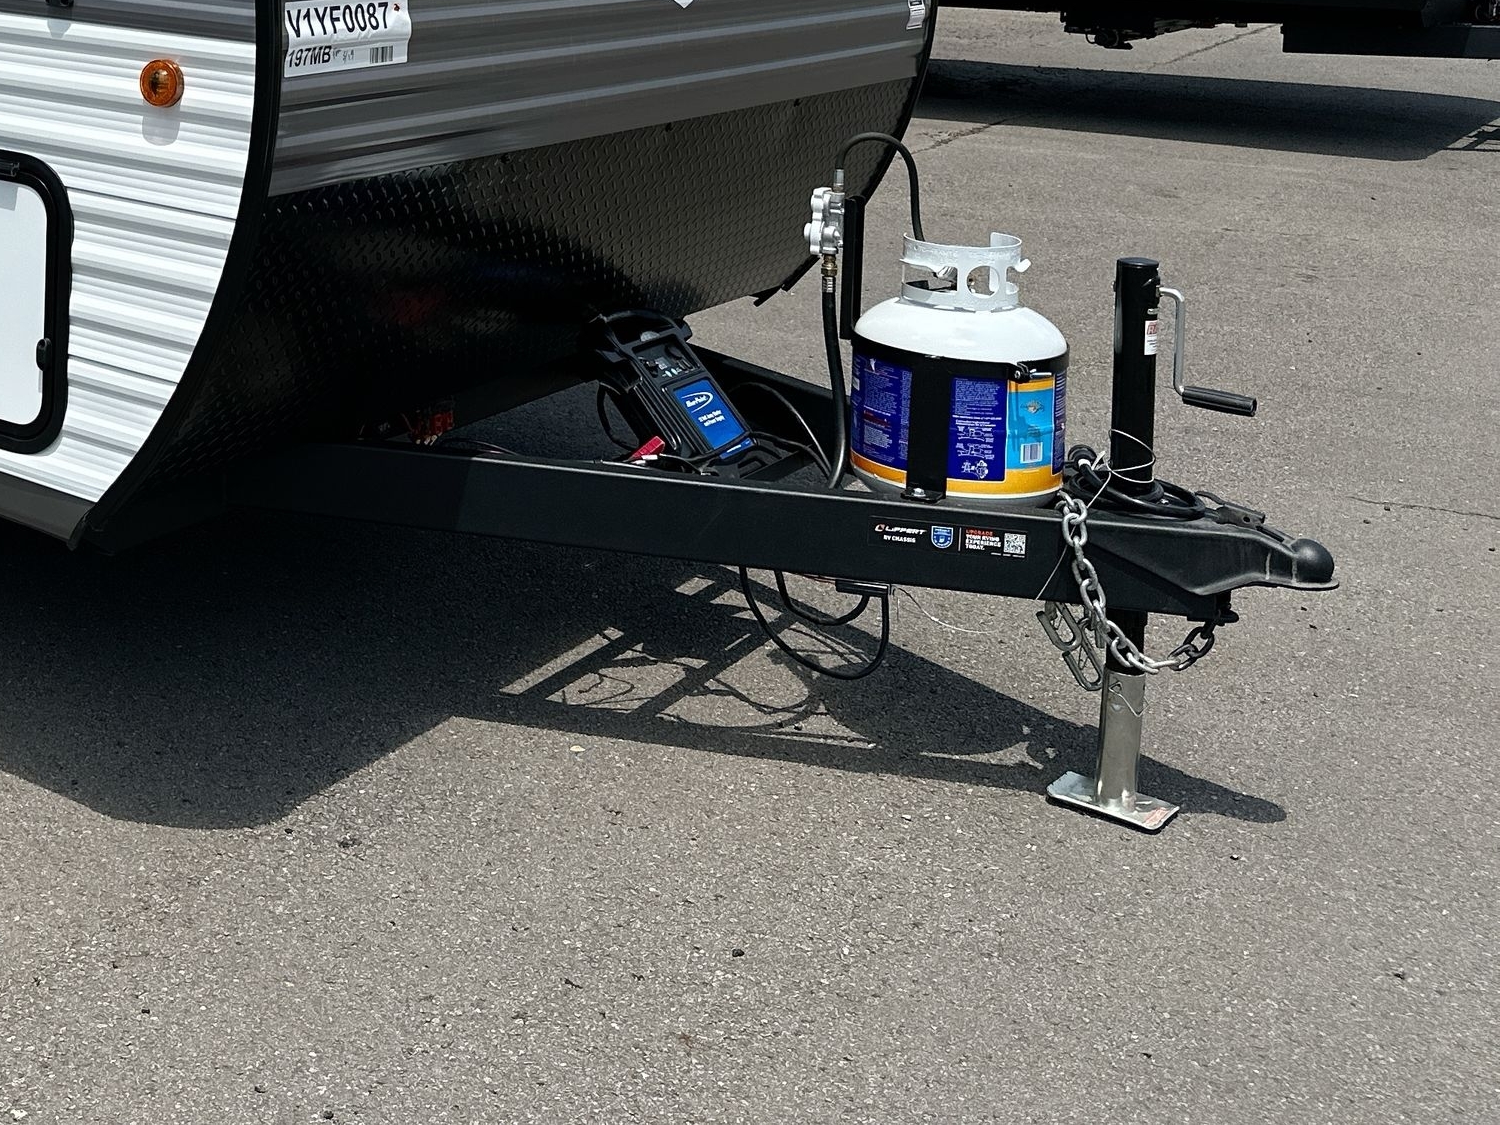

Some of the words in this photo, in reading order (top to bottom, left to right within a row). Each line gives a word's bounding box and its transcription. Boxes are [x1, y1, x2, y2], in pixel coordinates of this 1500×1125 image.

[286, 2, 388, 38] V1YF0087
[288, 45, 332, 67] 197MB
[885, 526, 927, 535] LIPPERT
